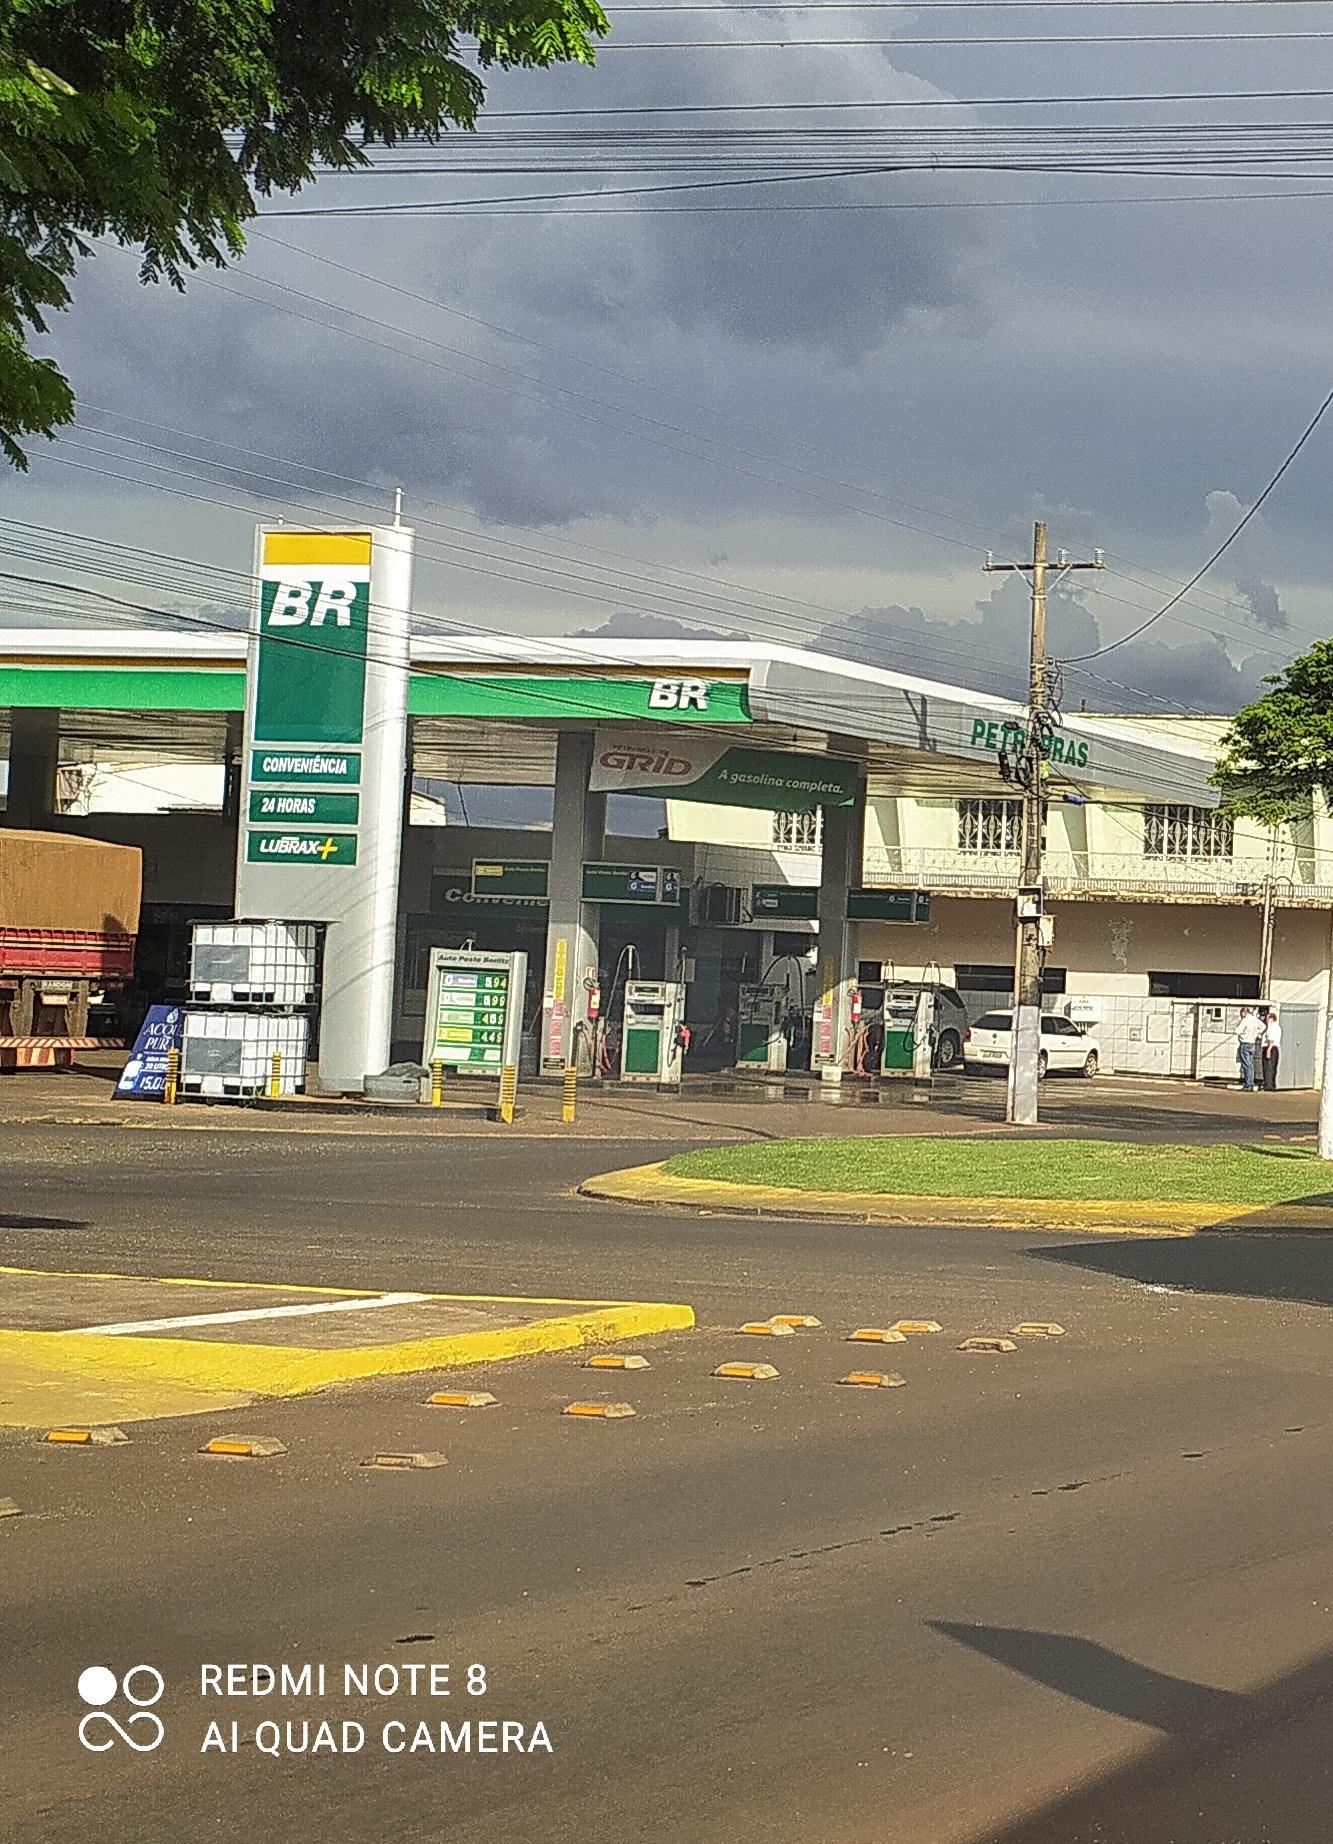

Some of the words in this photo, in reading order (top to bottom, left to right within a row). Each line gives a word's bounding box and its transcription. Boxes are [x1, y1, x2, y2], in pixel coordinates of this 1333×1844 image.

[267, 580, 357, 627] BR
[648, 679, 709, 710] BR
[971, 719, 1089, 768] PETRRAS
[718, 769, 729, 781] A
[730, 773, 785, 787] gasolina
[786, 778, 844, 795] completa.
[261, 797, 276, 813] 24
[277, 798, 316, 814] HORAS
[144, 1037, 171, 1050] PUR
